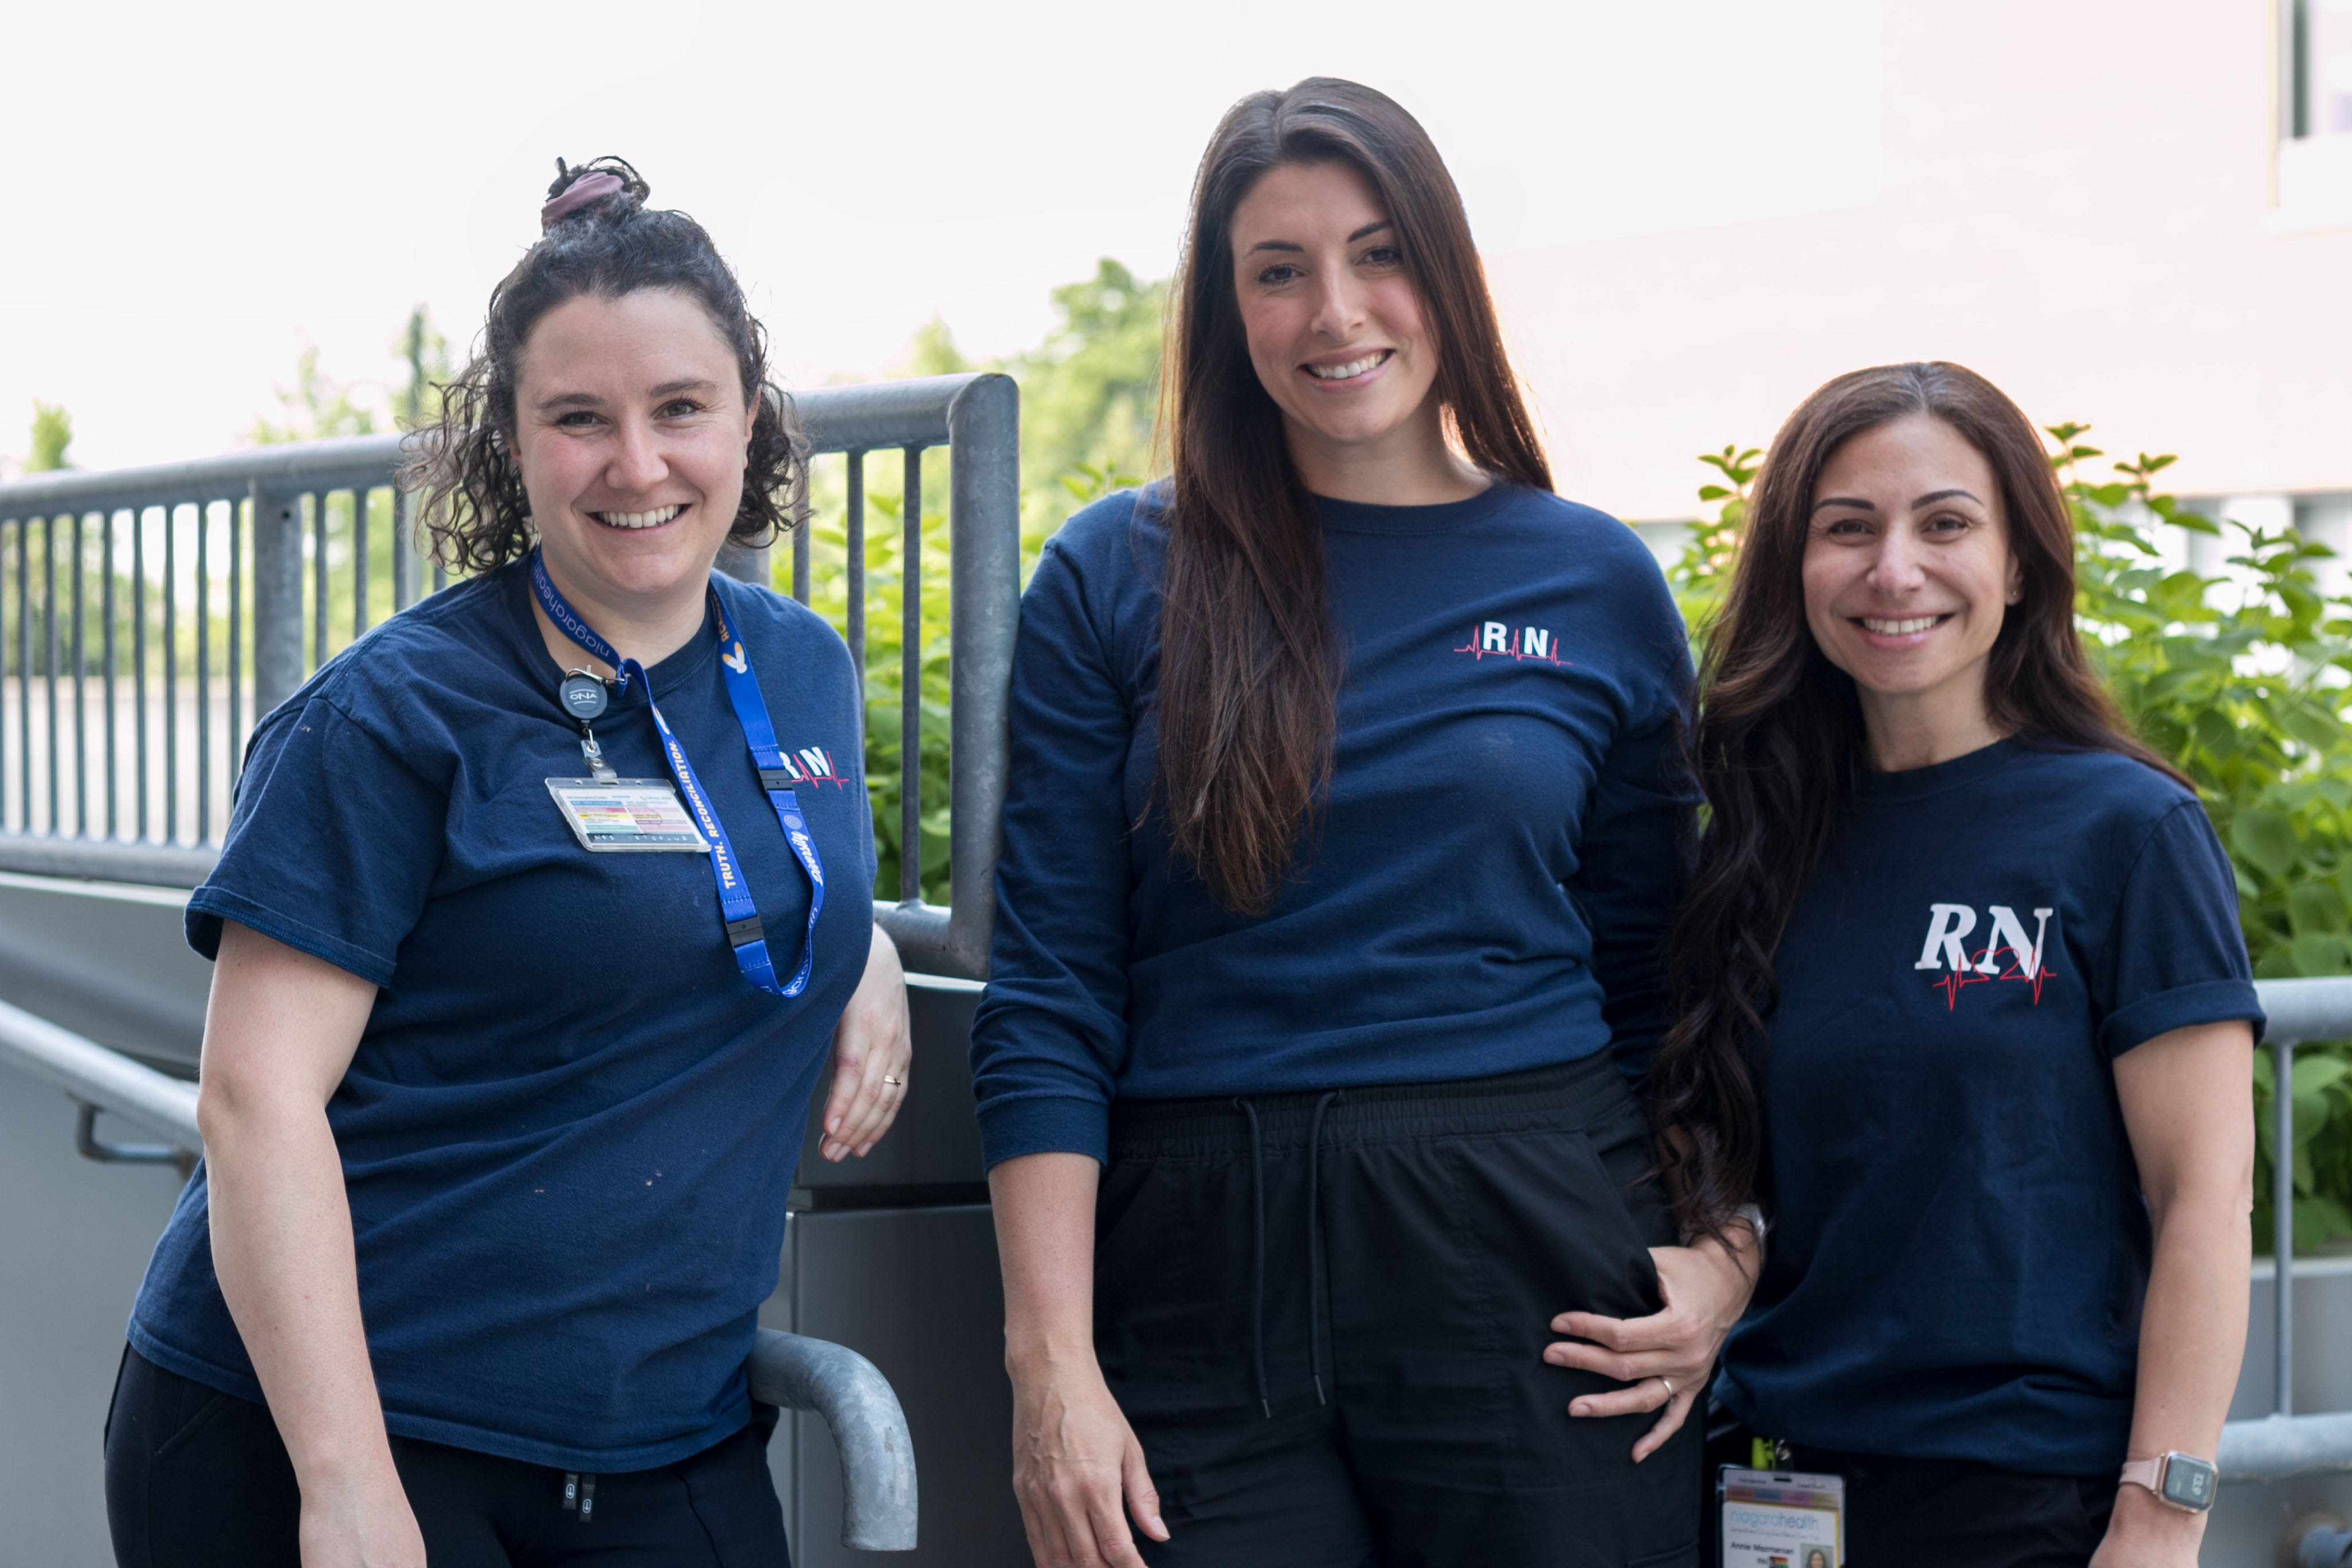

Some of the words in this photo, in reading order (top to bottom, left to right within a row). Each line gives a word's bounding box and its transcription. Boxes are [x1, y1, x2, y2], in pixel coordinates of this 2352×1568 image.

[1483, 621, 1549, 658] RN
[570, 692, 597, 700] ONA
[668, 740, 719, 838] RECONCILIATION.
[714, 842, 736, 889] TRUTH.
[1914, 903, 2053, 980] RN
